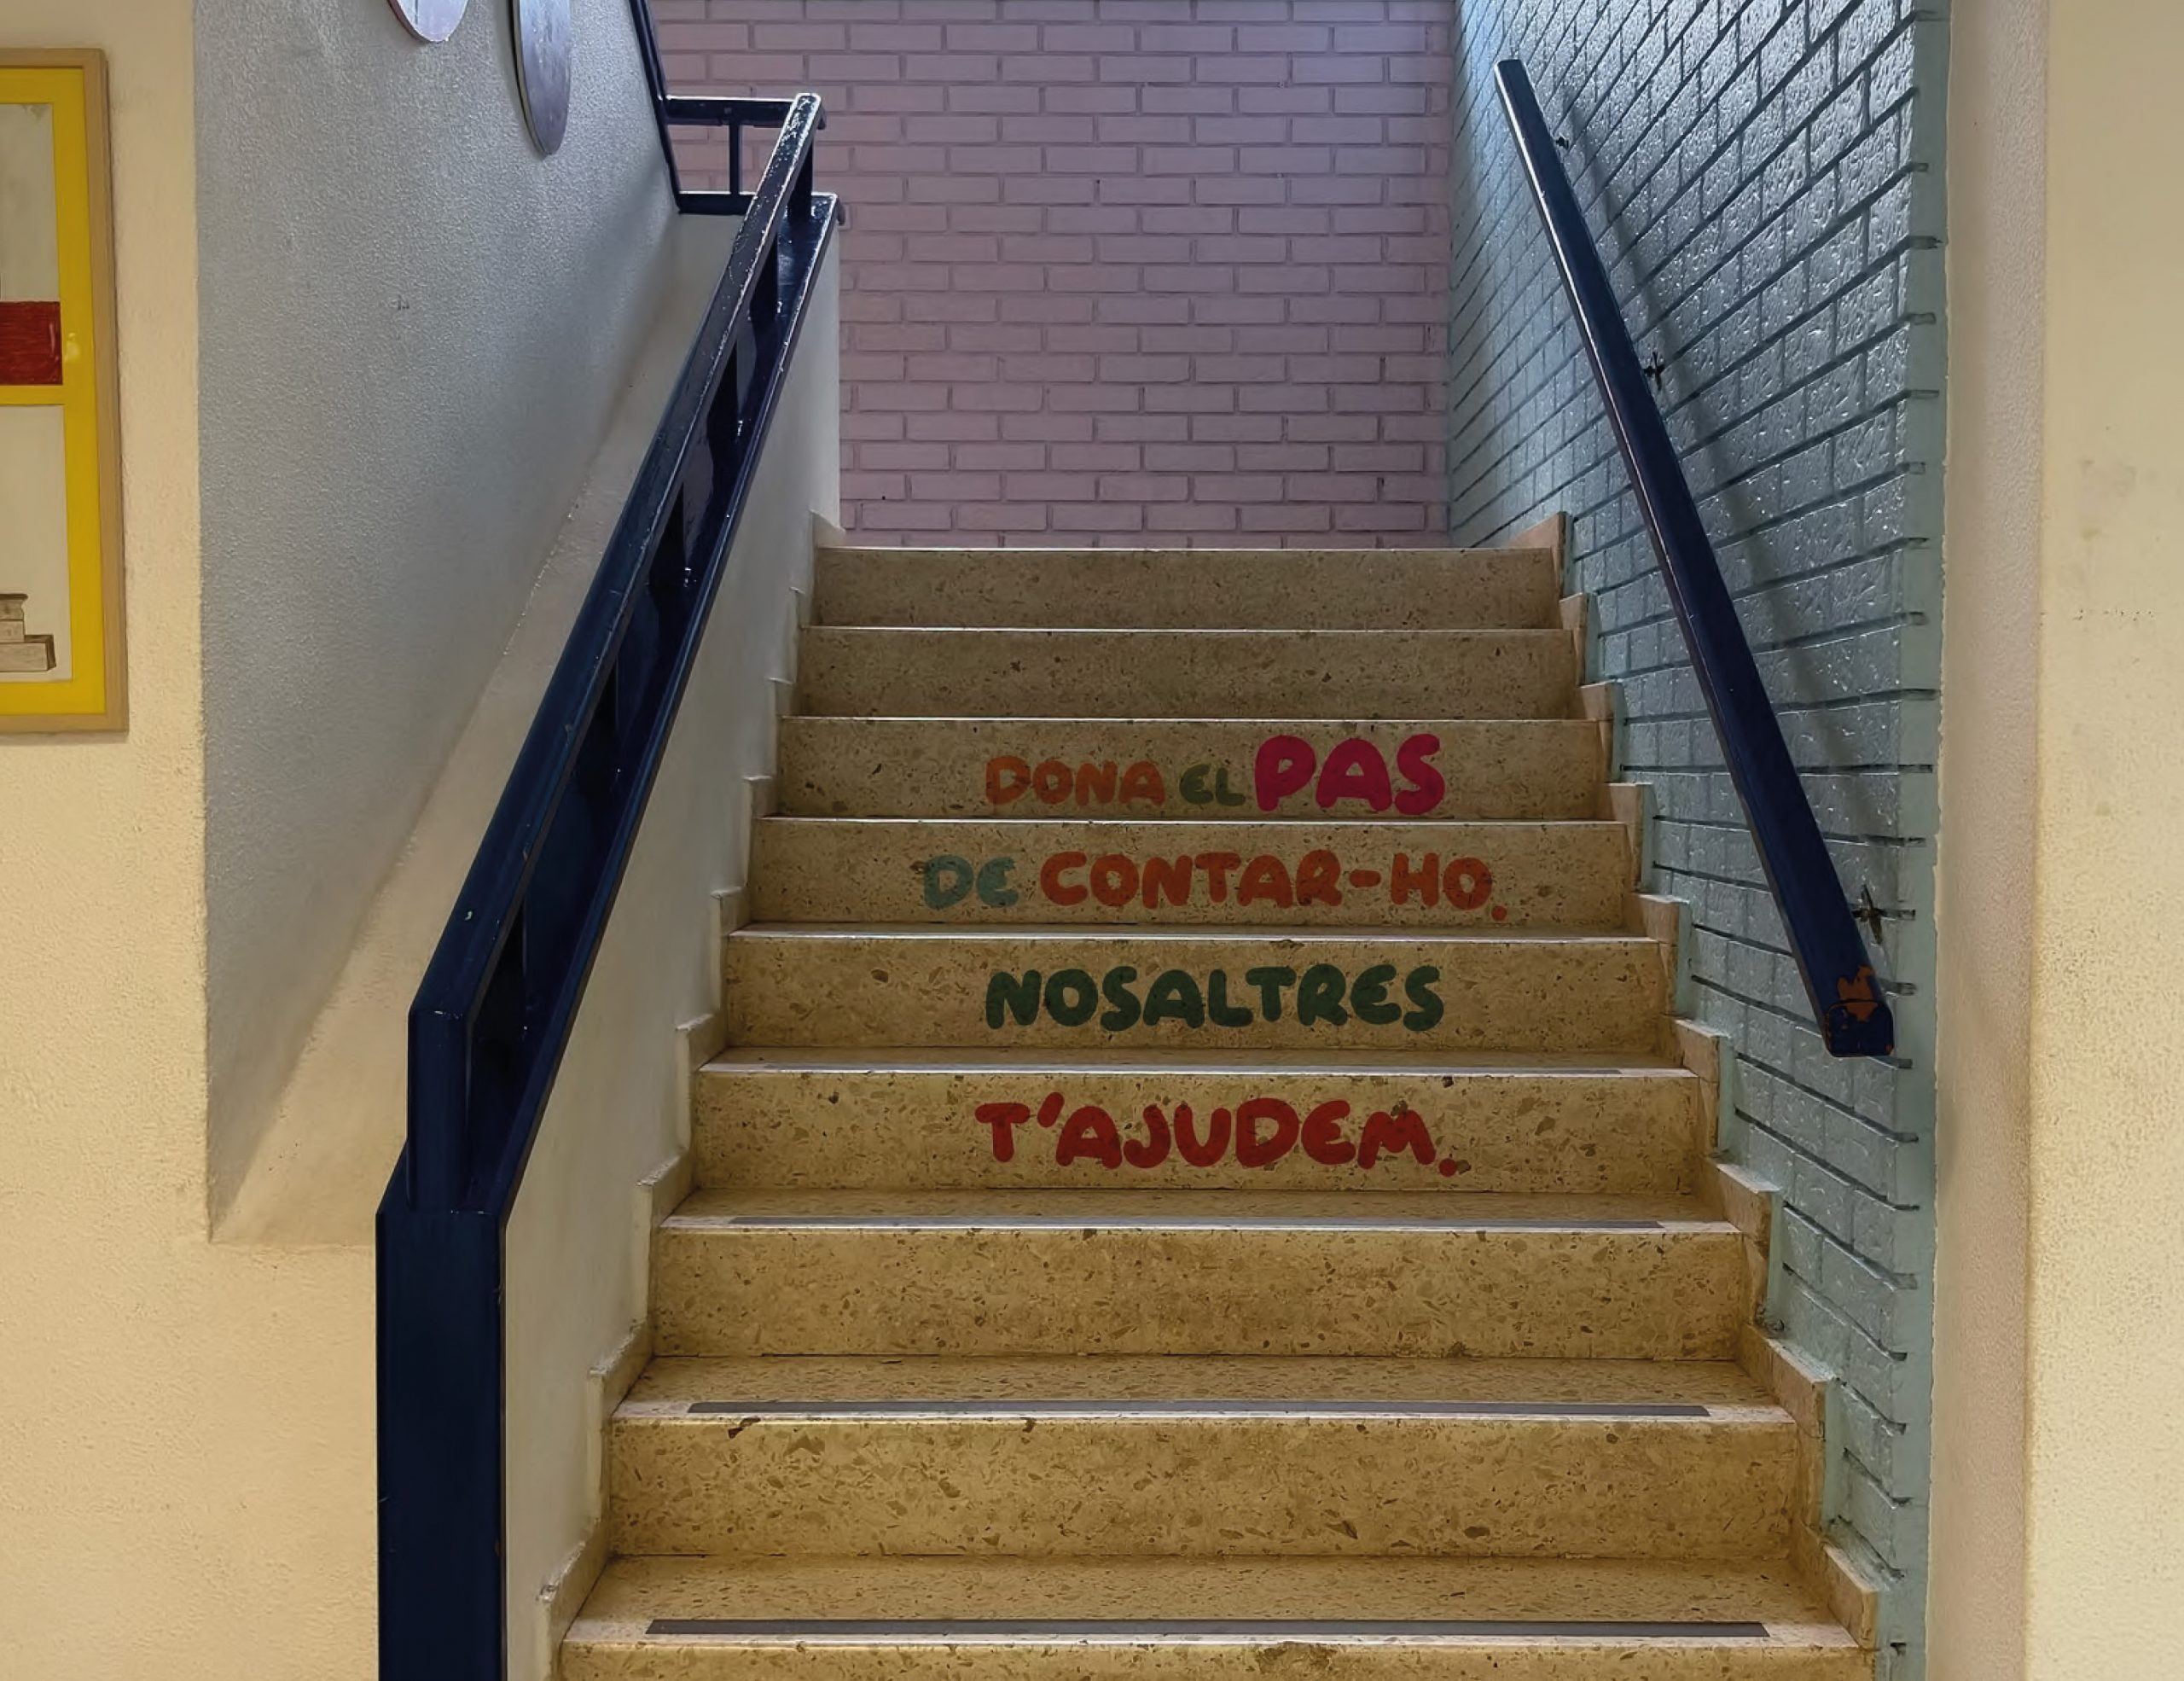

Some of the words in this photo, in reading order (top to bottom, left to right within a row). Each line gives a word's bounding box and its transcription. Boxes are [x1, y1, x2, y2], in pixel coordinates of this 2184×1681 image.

[985, 756, 1166, 806] DONA
[1179, 764, 1246, 806] EL
[1255, 734, 1446, 815] PAS
[922, 855, 1019, 909] DE
[1040, 850, 1507, 921] CONTAR-HO.
[985, 964, 1444, 1031] NOSALTRES
[974, 1092, 1459, 1177] T'AJUDEM.
